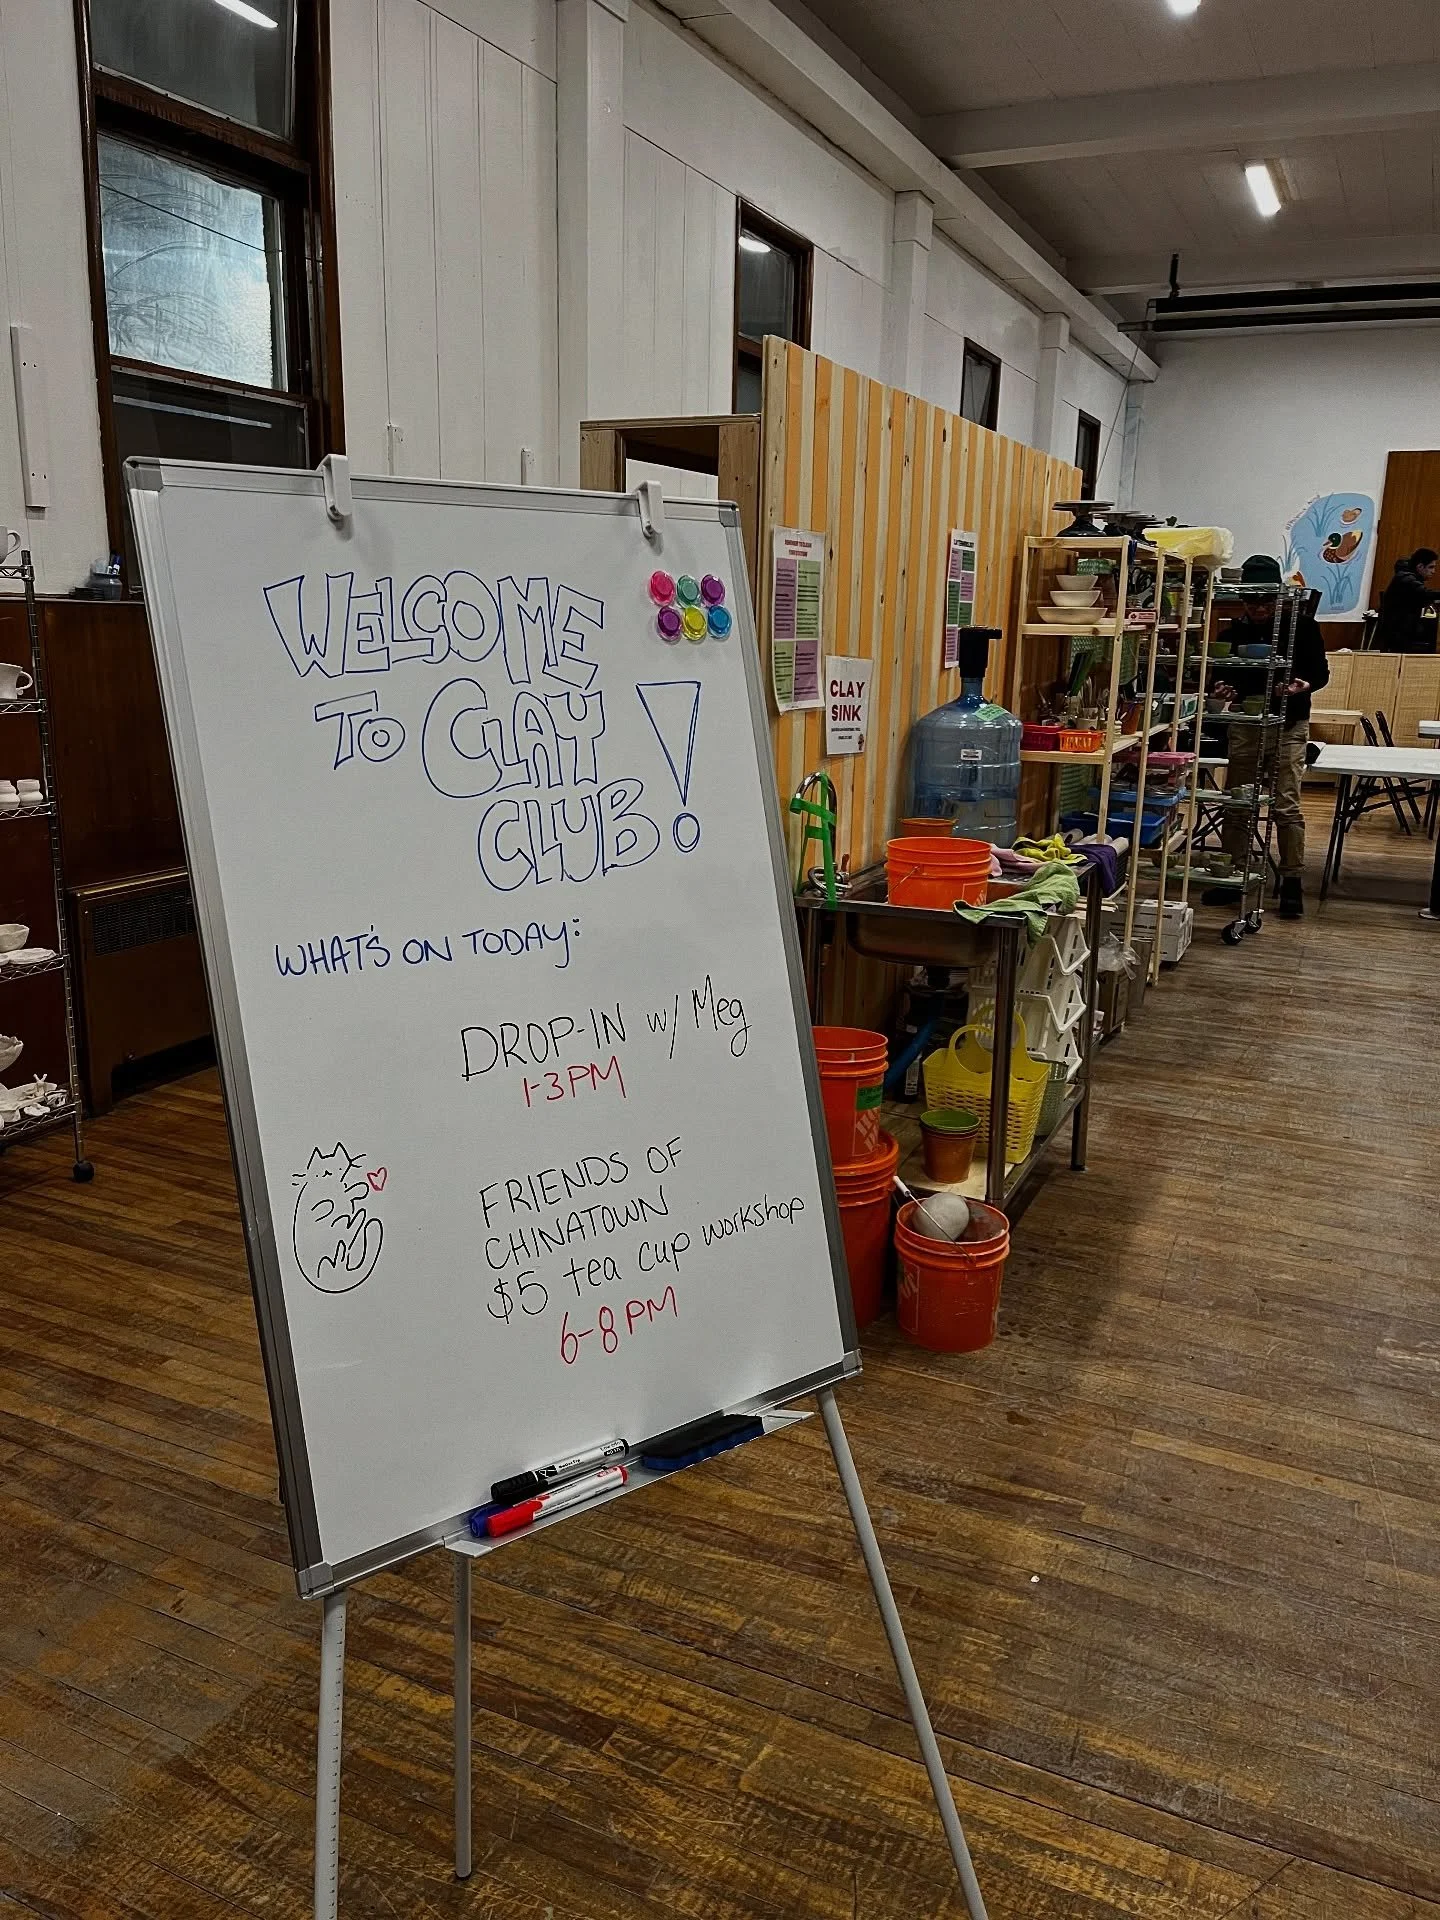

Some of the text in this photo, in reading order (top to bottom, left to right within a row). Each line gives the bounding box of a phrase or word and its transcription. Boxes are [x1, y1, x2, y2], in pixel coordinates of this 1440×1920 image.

[263, 571, 604, 687] WELCOME
[830, 680, 865, 697] CLAY
[832, 705, 862, 721] SINK
[422, 678, 605, 798] CLAY
[276, 919, 580, 976] WHAT'S ON TODAY:
[461, 1003, 626, 1082] DROP-IN
[692, 975, 752, 1057] Meg
[479, 1137, 681, 1228] FRIENDS OF
[485, 1185, 669, 1271] CHINATOWN
[487, 1194, 804, 1324] $5 tea cup workshop
